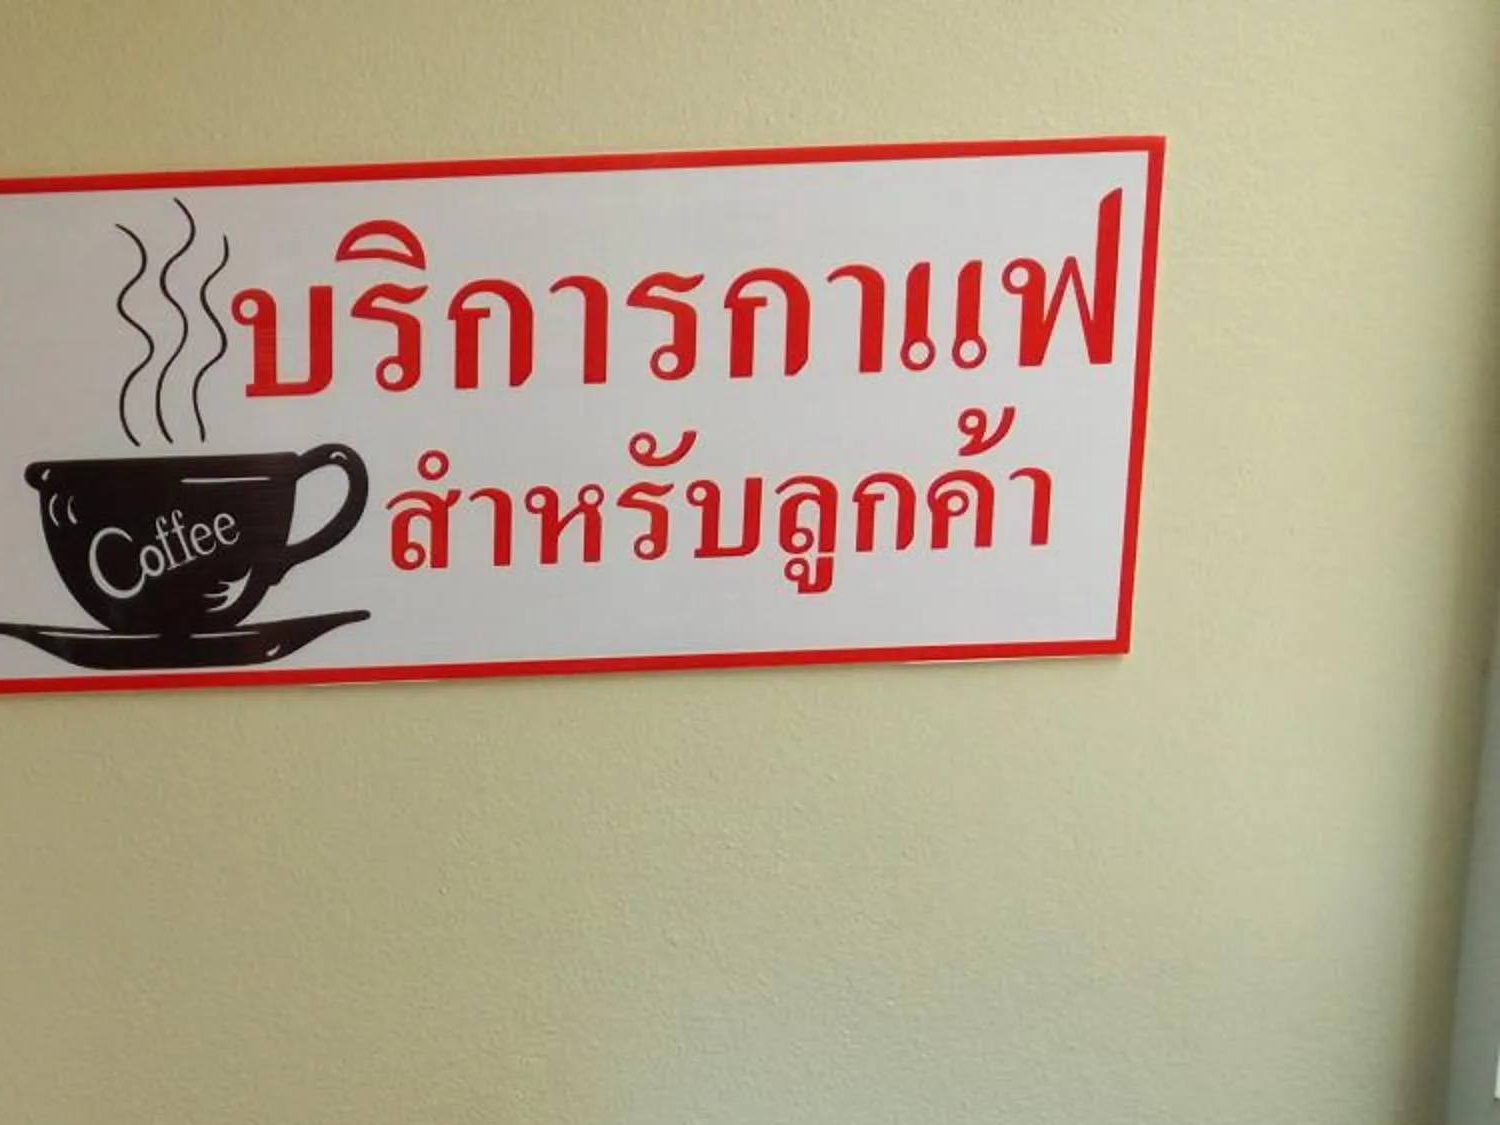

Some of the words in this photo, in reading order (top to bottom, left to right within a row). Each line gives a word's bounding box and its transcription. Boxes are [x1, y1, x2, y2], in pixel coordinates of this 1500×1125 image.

[231, 188, 1124, 400] บริการกาแฟ
[88, 509, 241, 599] Coffee
[387, 406, 1053, 597] สำหรับลูกค้า
